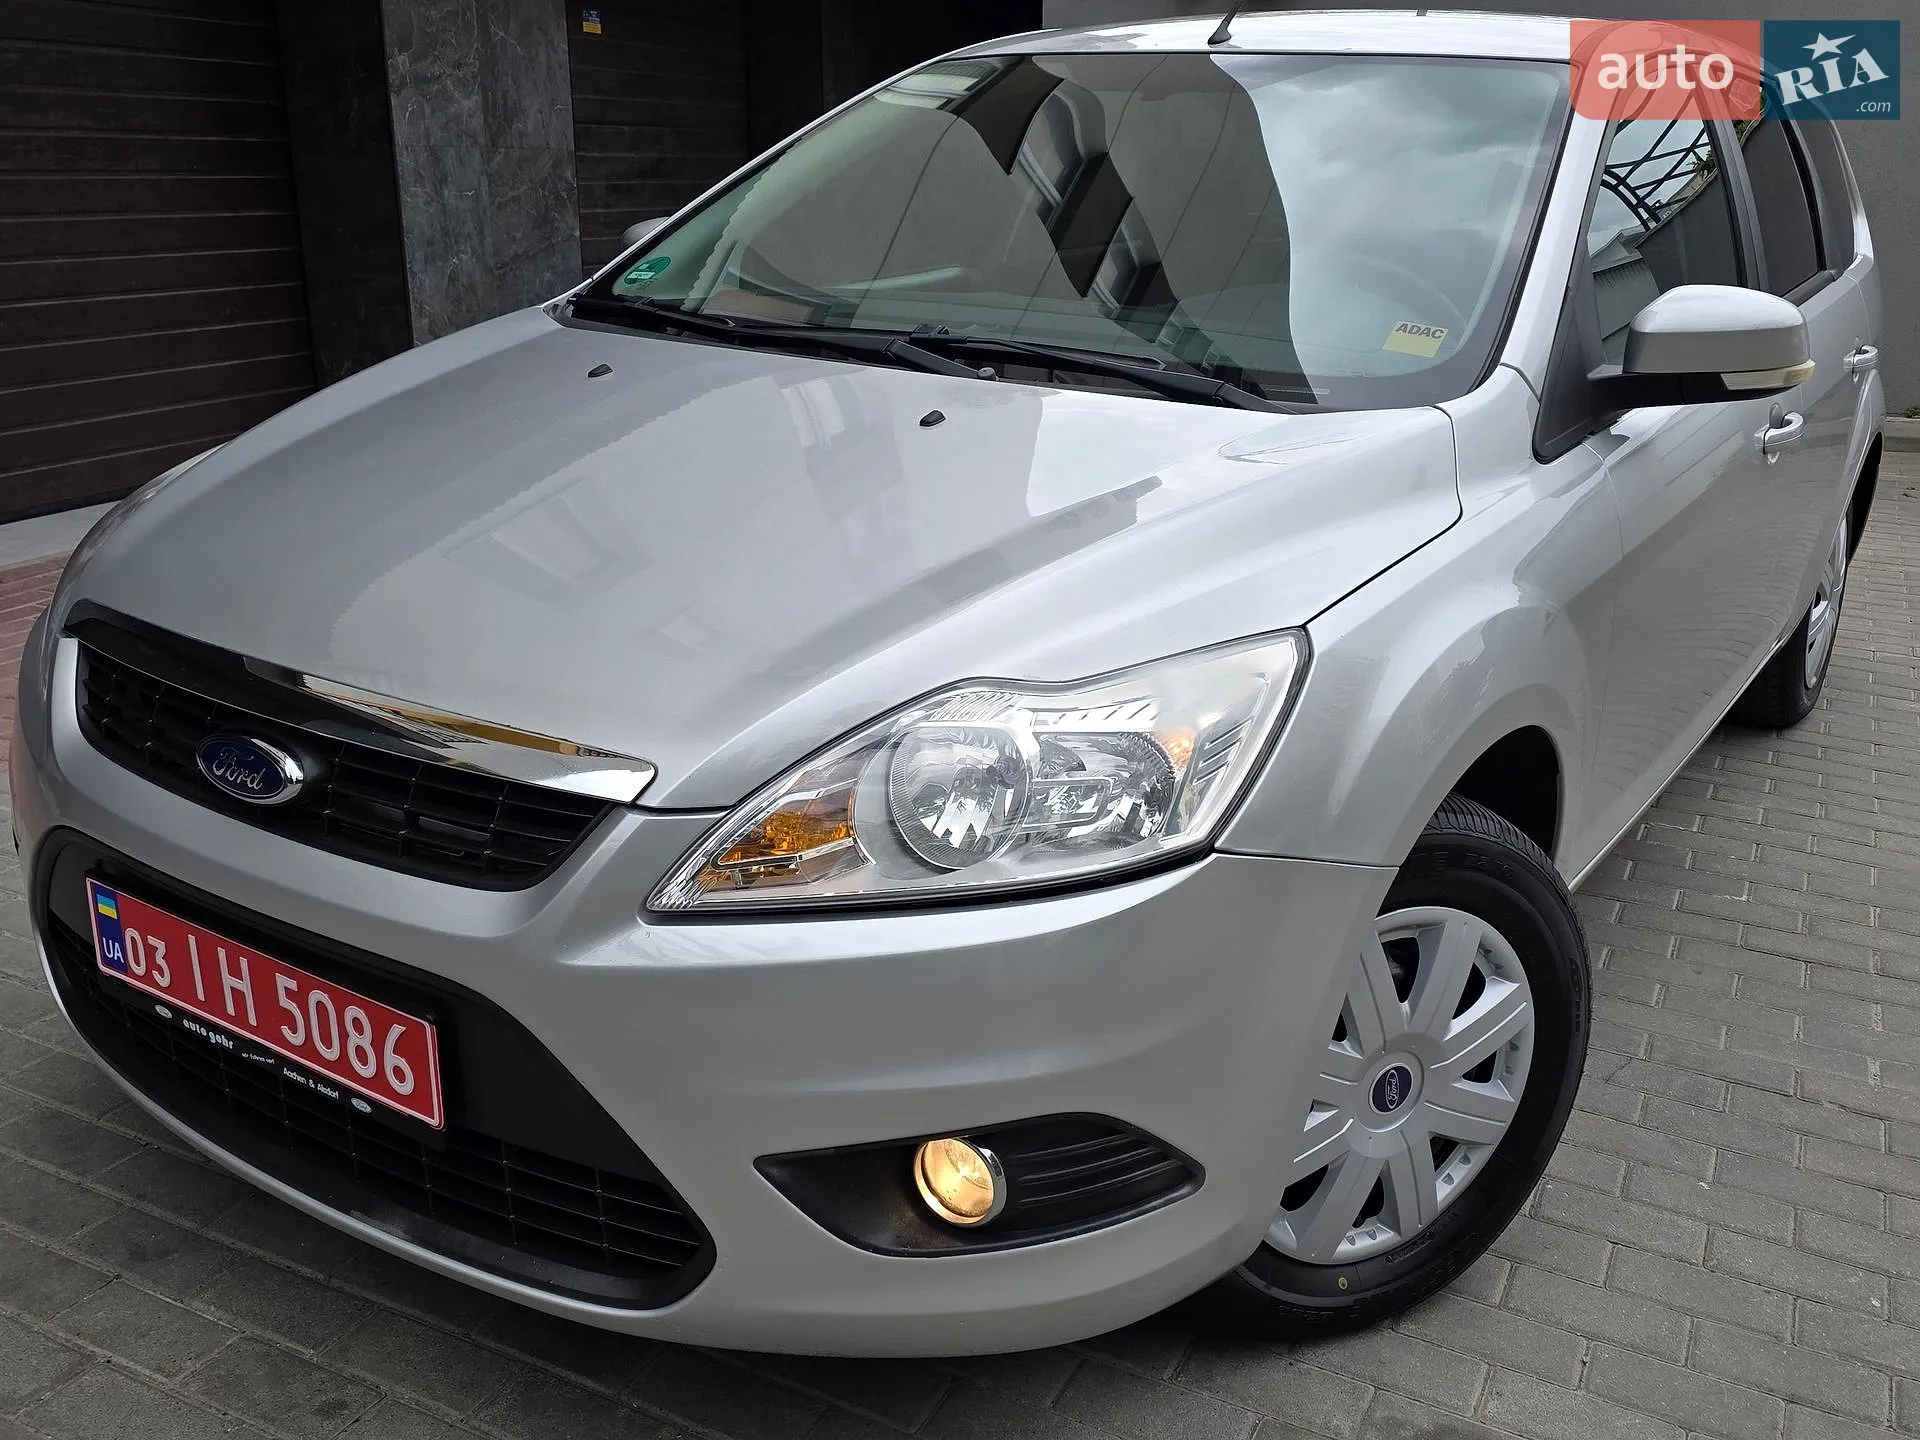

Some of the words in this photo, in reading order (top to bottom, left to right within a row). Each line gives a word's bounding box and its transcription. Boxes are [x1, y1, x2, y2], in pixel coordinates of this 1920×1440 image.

[1395, 323, 1445, 339] ADAC
[212, 747, 267, 790] Ford
[102, 936, 125, 964] UA
[125, 927, 171, 988] 03
[274, 971, 415, 1096] 5086
[182, 1019, 207, 1036] auto
